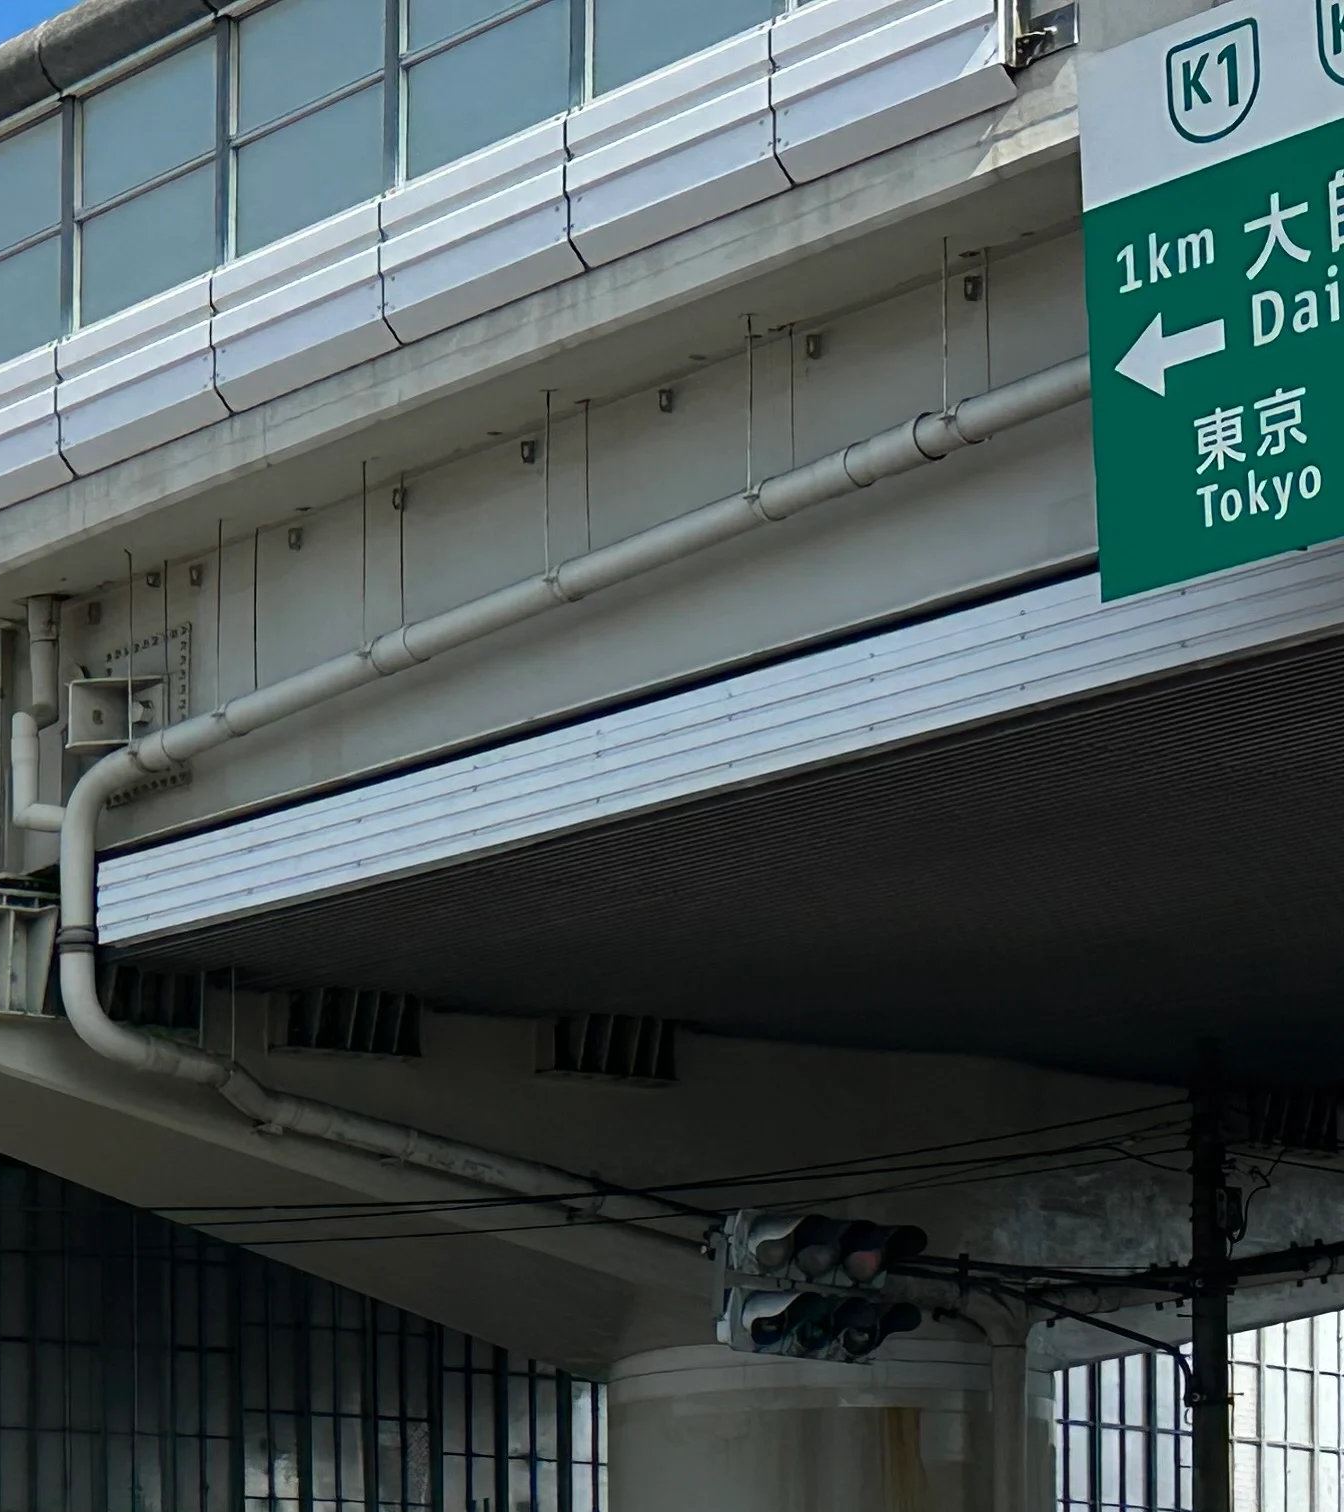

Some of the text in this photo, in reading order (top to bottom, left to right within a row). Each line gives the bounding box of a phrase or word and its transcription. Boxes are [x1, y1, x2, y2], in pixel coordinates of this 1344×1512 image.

[1182, 43, 1240, 111] K1
[1115, 169, 1344, 294] 1km 大
[1193, 386, 1307, 475] 東京
[1196, 465, 1322, 528] Tokyo
